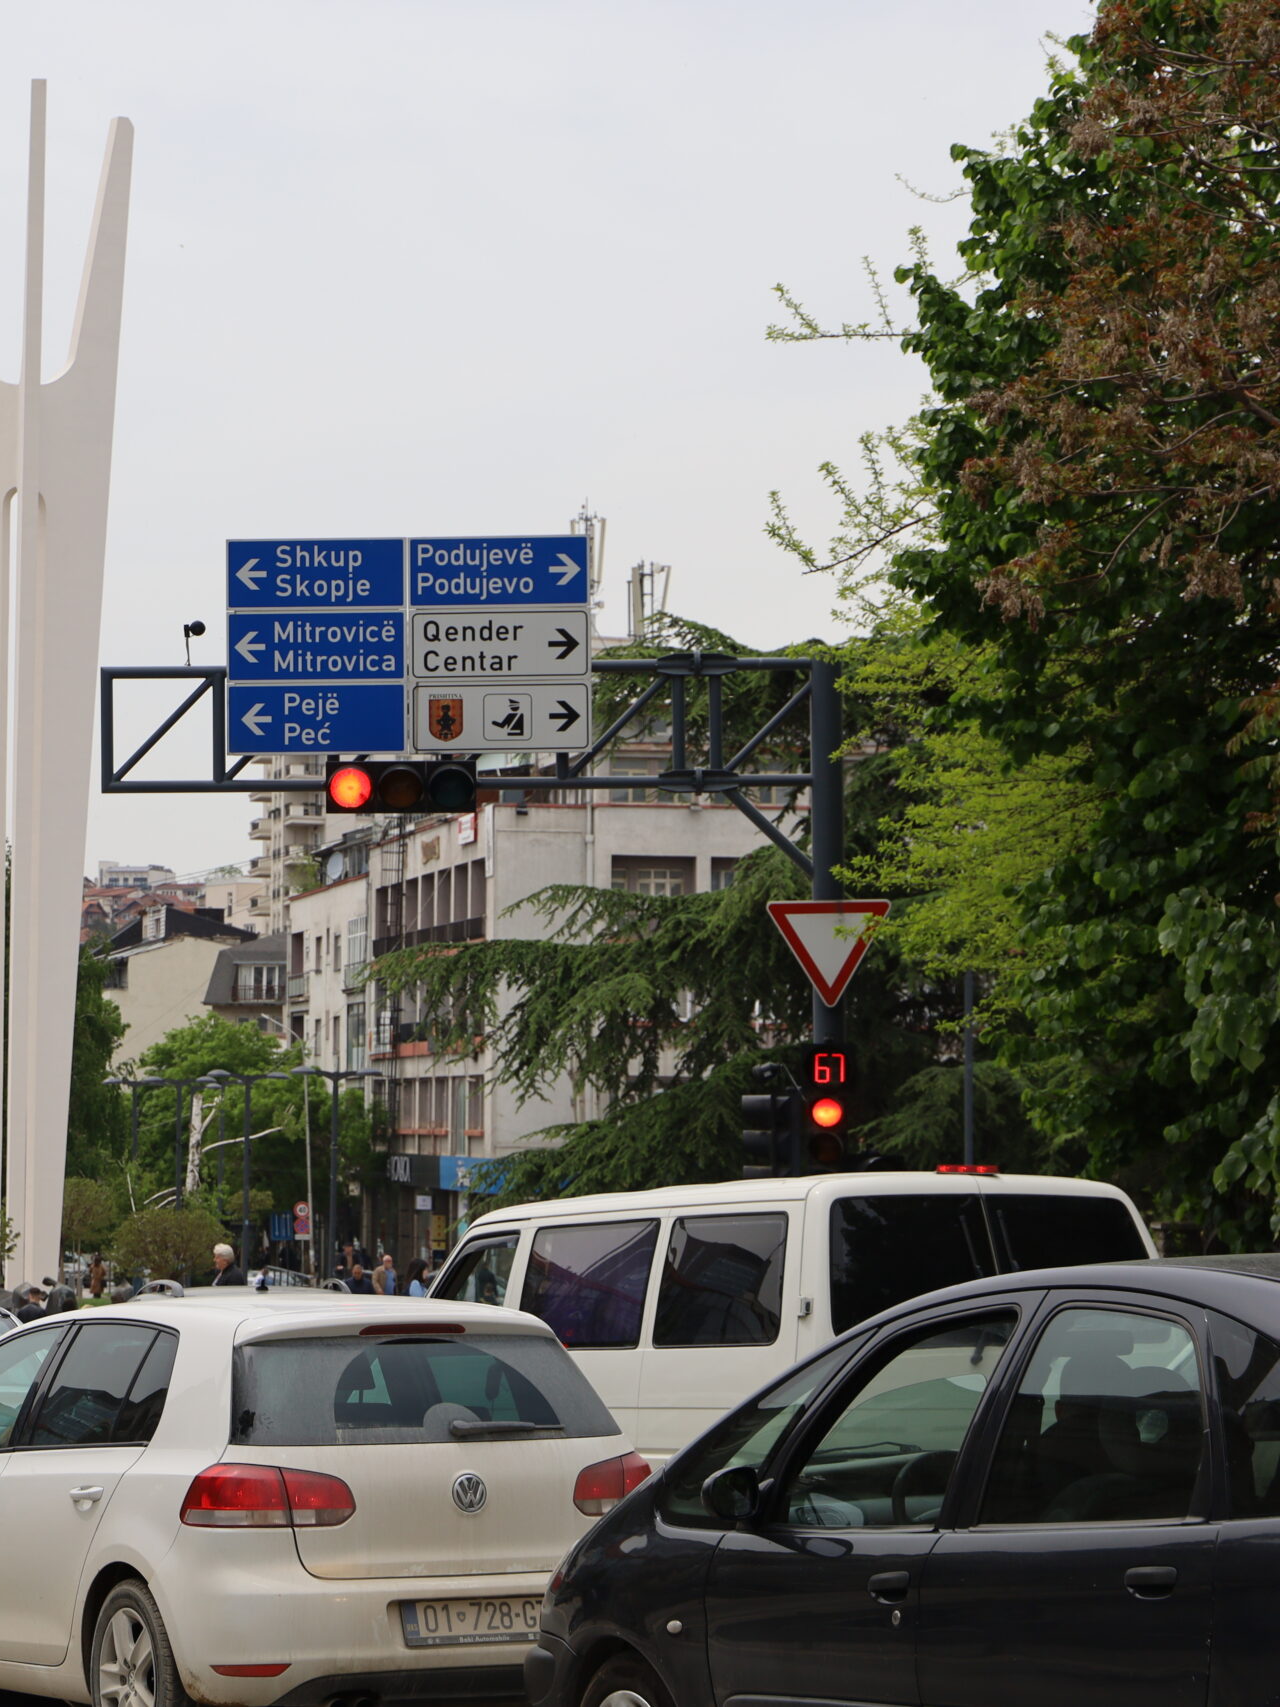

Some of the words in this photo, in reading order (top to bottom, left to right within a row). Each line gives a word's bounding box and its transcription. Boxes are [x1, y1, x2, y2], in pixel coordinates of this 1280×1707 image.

[275, 545, 363, 570] Shkup
[417, 542, 534, 573] Podujevë
[275, 574, 371, 602] Skopje
[417, 572, 534, 600] Podujevo
[273, 620, 396, 643] Mitrovicë
[423, 620, 524, 643] Qender
[273, 649, 396, 673] Mitrovica
[423, 649, 518, 672] Centar
[284, 692, 340, 720] Pejë
[284, 722, 331, 745] Peć
[814, 1053, 846, 1084] 67
[423, 1603, 453, 1633] 01
